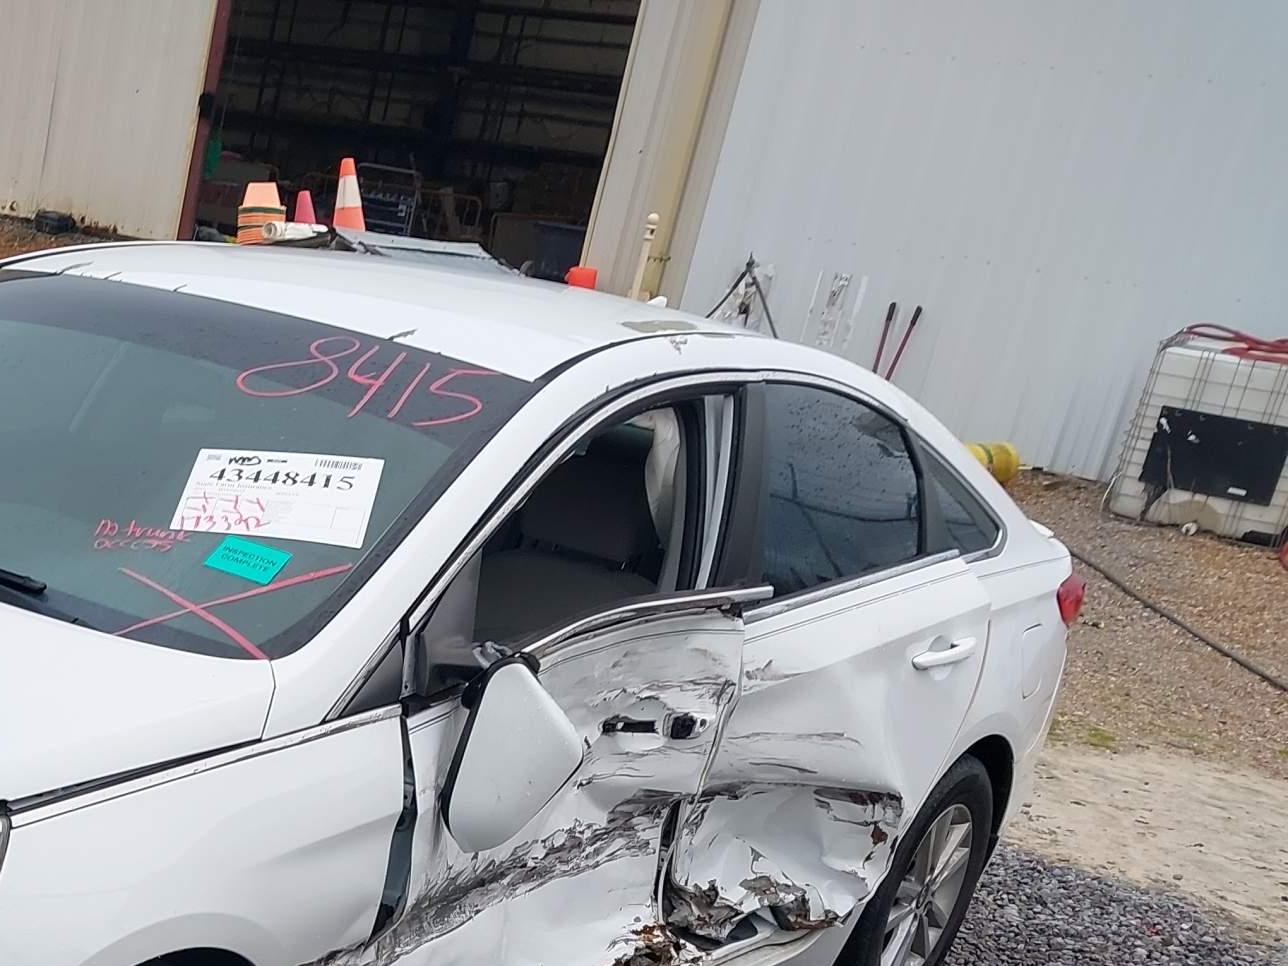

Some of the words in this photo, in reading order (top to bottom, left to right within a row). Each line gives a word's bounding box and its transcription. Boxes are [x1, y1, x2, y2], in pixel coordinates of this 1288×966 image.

[236, 336, 502, 426] 8415
[209, 467, 356, 491] 43448415
[225, 545, 277, 568] INSPECTION
